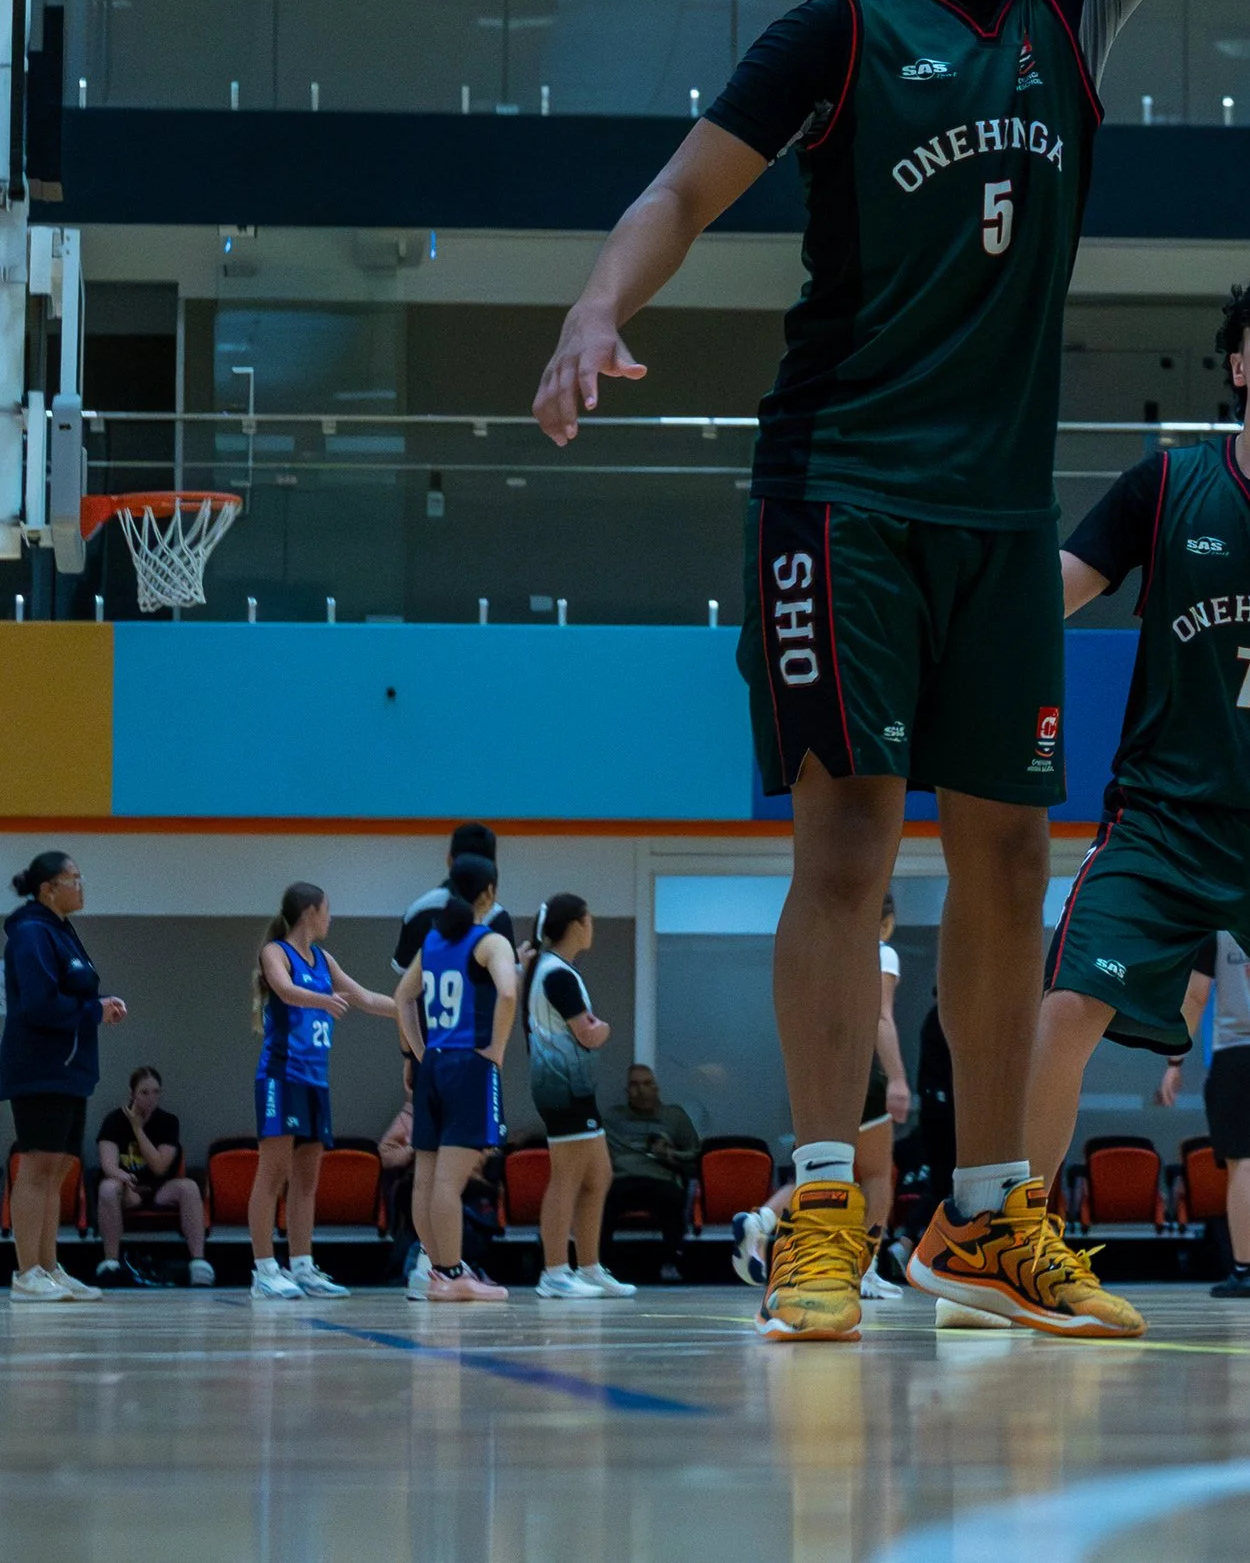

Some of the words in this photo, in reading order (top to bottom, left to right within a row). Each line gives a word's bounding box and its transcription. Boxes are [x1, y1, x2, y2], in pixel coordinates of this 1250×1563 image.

[901, 63, 948, 76] SAS
[983, 179, 1014, 256] 5
[1186, 539, 1223, 552] SAS
[772, 550, 821, 687] OHS
[422, 969, 464, 1030] 29
